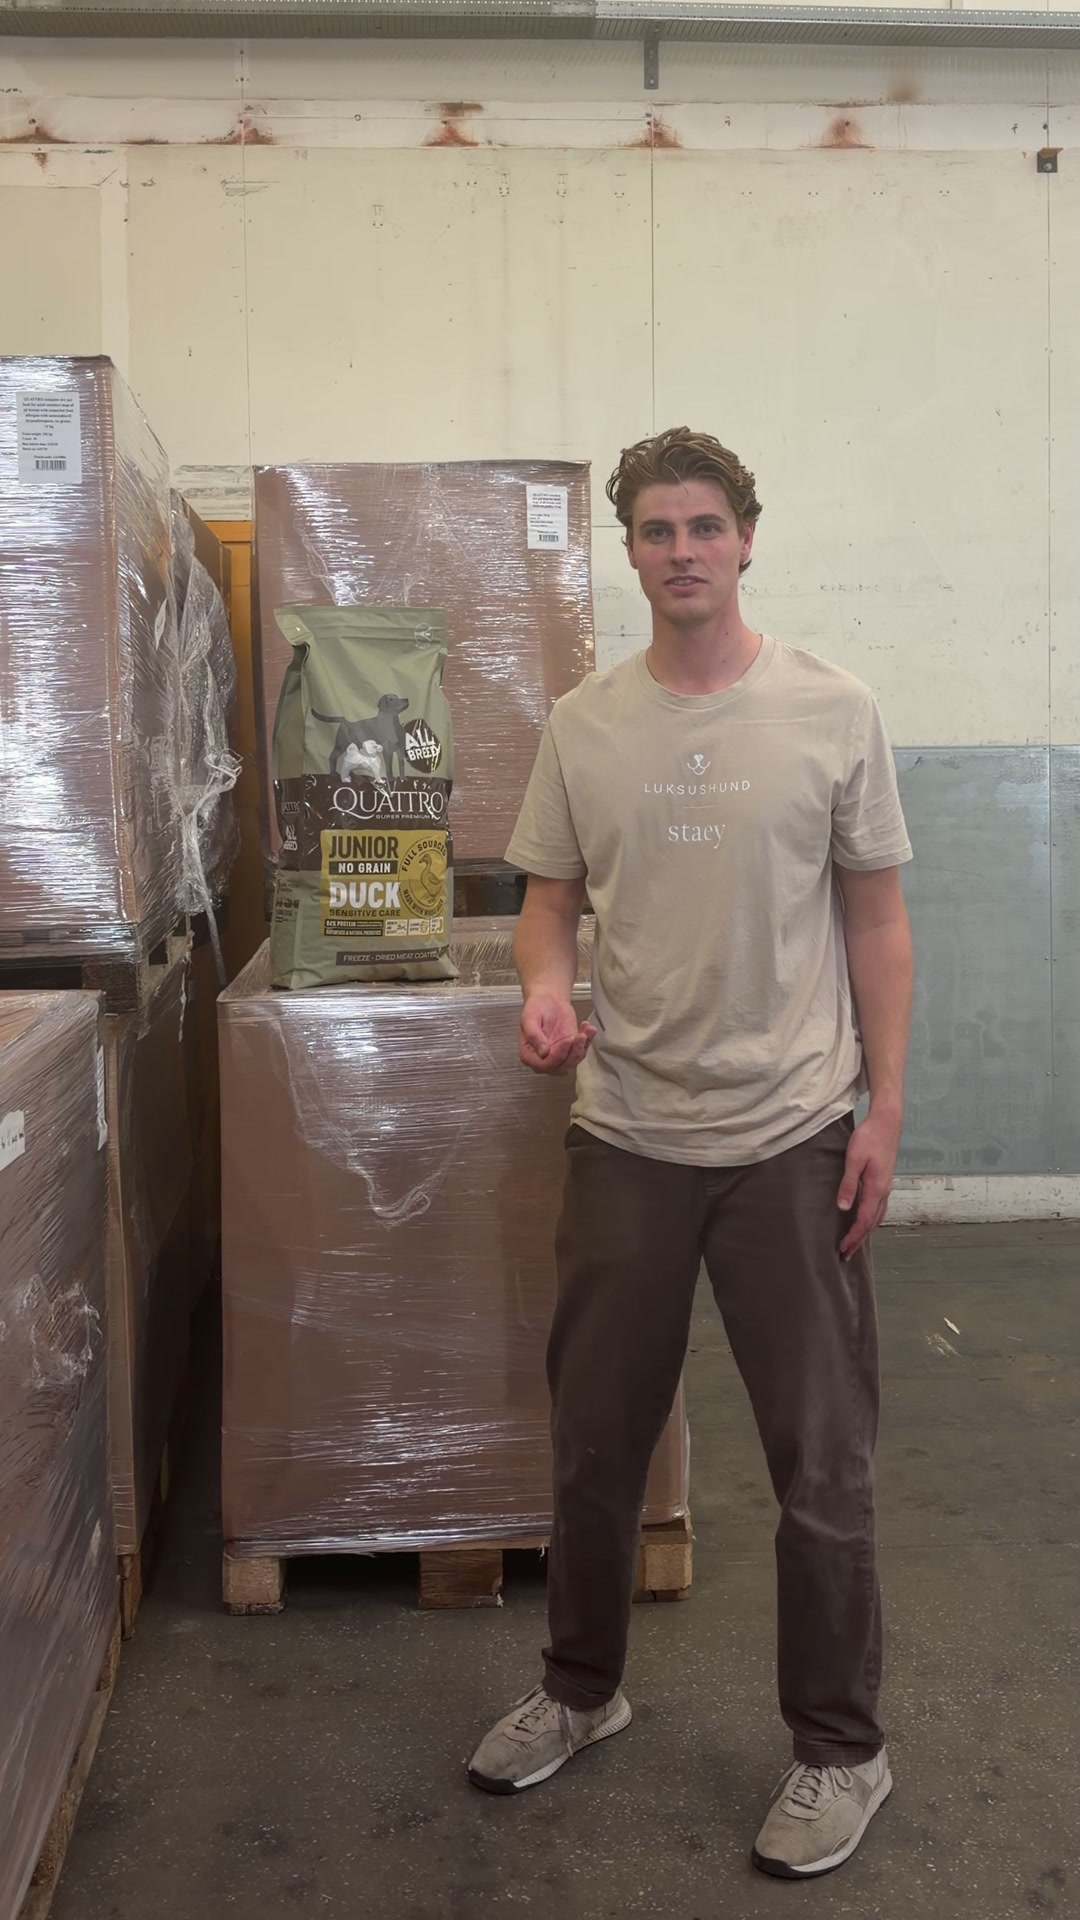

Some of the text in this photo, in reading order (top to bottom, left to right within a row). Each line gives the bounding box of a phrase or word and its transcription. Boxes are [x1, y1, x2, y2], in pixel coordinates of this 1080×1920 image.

[405, 728, 436, 750] ALL
[644, 780, 751, 795] LUKSUSHUND
[328, 786, 444, 820] QUATTRO
[328, 835, 399, 859] JUNIOR
[338, 862, 391, 873] NO GRAIN
[401, 850, 417, 872] FULL
[329, 881, 401, 909] DUCK
[329, 909, 377, 917] SENSITIVE
